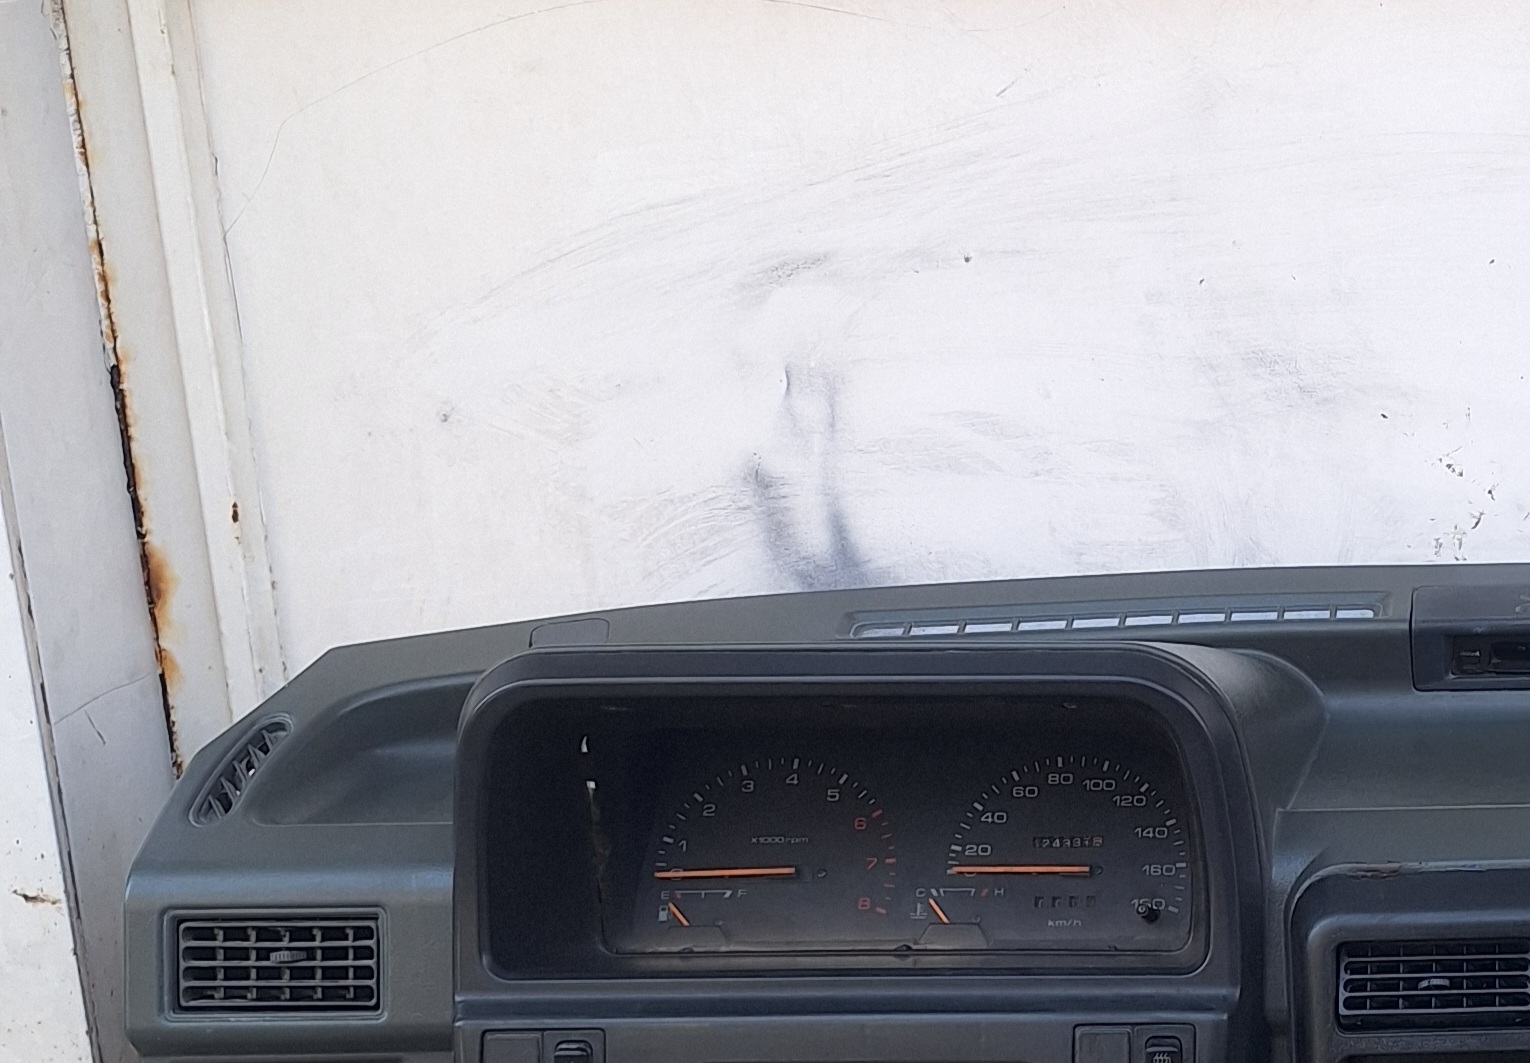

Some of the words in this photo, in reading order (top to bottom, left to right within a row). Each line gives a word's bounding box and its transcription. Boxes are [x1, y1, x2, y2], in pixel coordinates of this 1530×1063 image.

[785, 774, 800, 786] 4
[1047, 773, 1075, 786] 80
[1082, 779, 1117, 792] 100
[741, 780, 755, 793] 3
[1011, 786, 1039, 798] 60
[827, 789, 841, 802] 5
[1112, 795, 1148, 808] 120
[702, 804, 717, 817] 2
[854, 817, 867, 830] 6
[980, 811, 1008, 824] 40
[1133, 826, 1169, 839] 140
[677, 840, 688, 852] 1
[964, 844, 992, 856] 20
[866, 858, 878, 870] 7
[1142, 864, 1176, 877] 160
[660, 891, 670, 900] E
[737, 889, 747, 899] F
[915, 888, 926, 898] C
[994, 887, 1005, 897] H
[858, 897, 872, 910] 8
